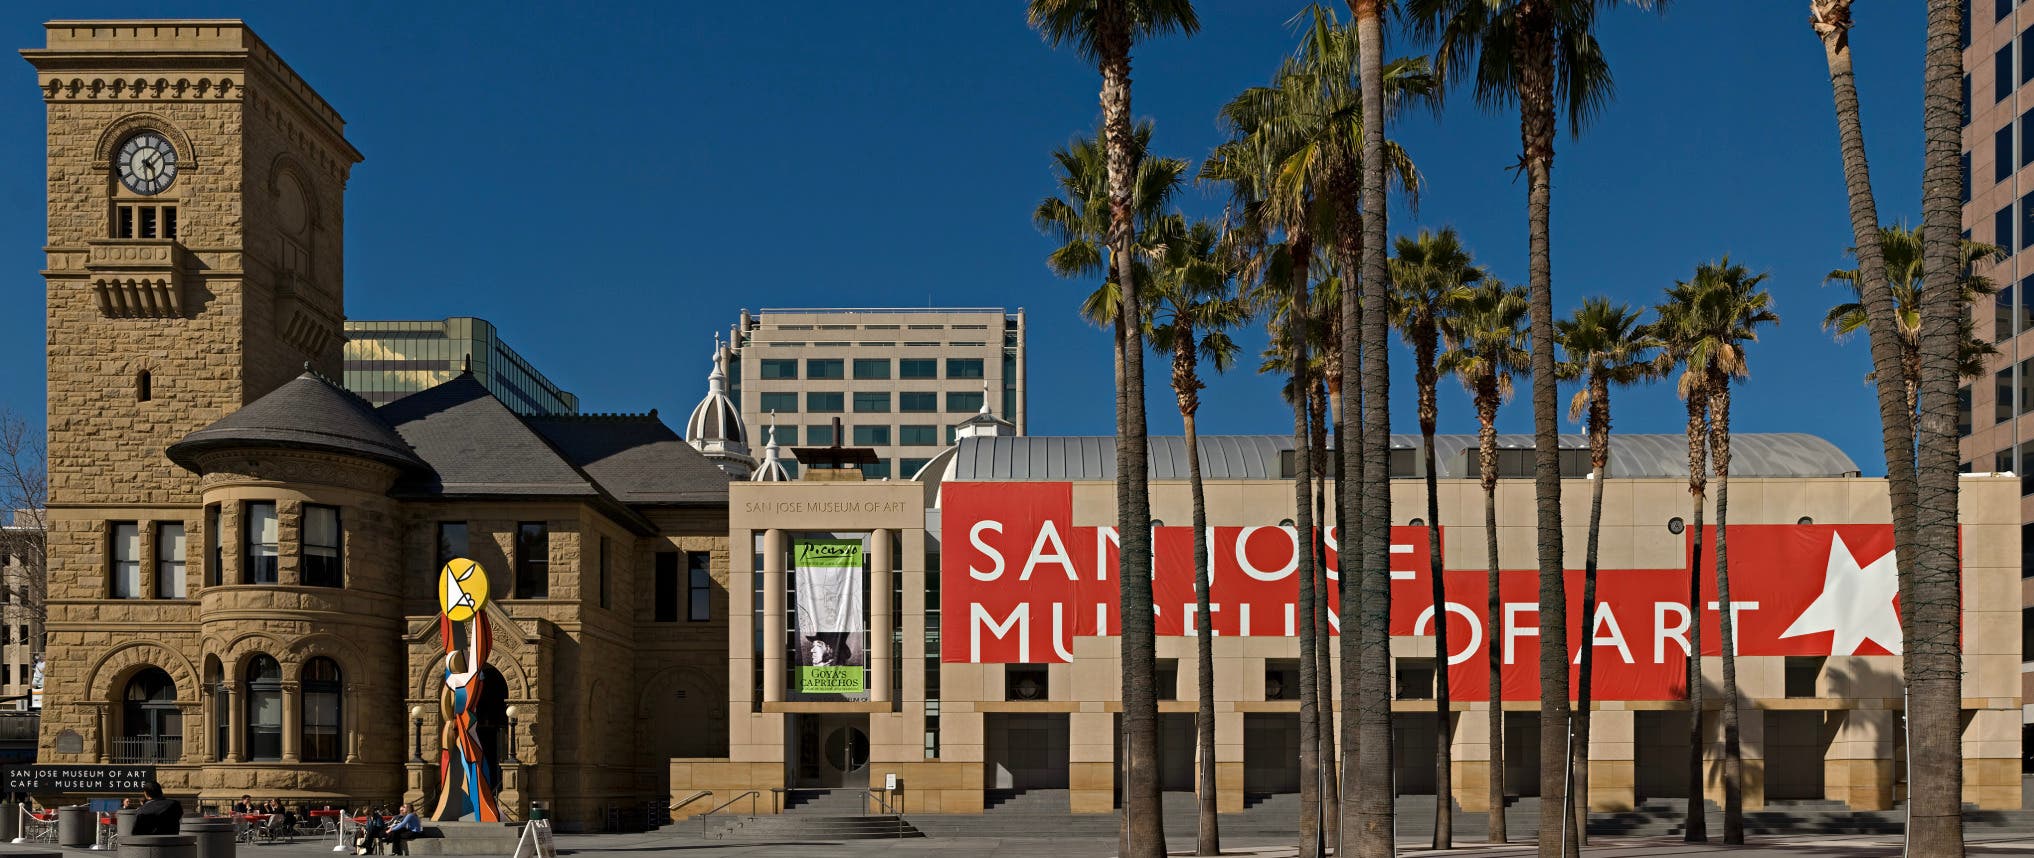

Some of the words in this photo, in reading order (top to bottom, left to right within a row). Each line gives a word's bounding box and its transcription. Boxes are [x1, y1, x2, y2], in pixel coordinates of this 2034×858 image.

[746, 502, 772, 513] SAN
[776, 502, 802, 514] JOSE
[807, 502, 860, 513] MUSEUM
[864, 502, 880, 513] OF
[883, 502, 906, 513] ART
[1414, 602, 1540, 665] OF
[1573, 601, 1760, 664] ART
[800, 679, 859, 687] CAPRICHOS
[10, 770, 31, 778] SAN
[34, 770, 58, 779] JOSE
[62, 770, 104, 778] MUSEUM
[108, 770, 122, 778] OF
[126, 770, 147, 778] ART
[55, 780, 102, 788] MUSEUM
